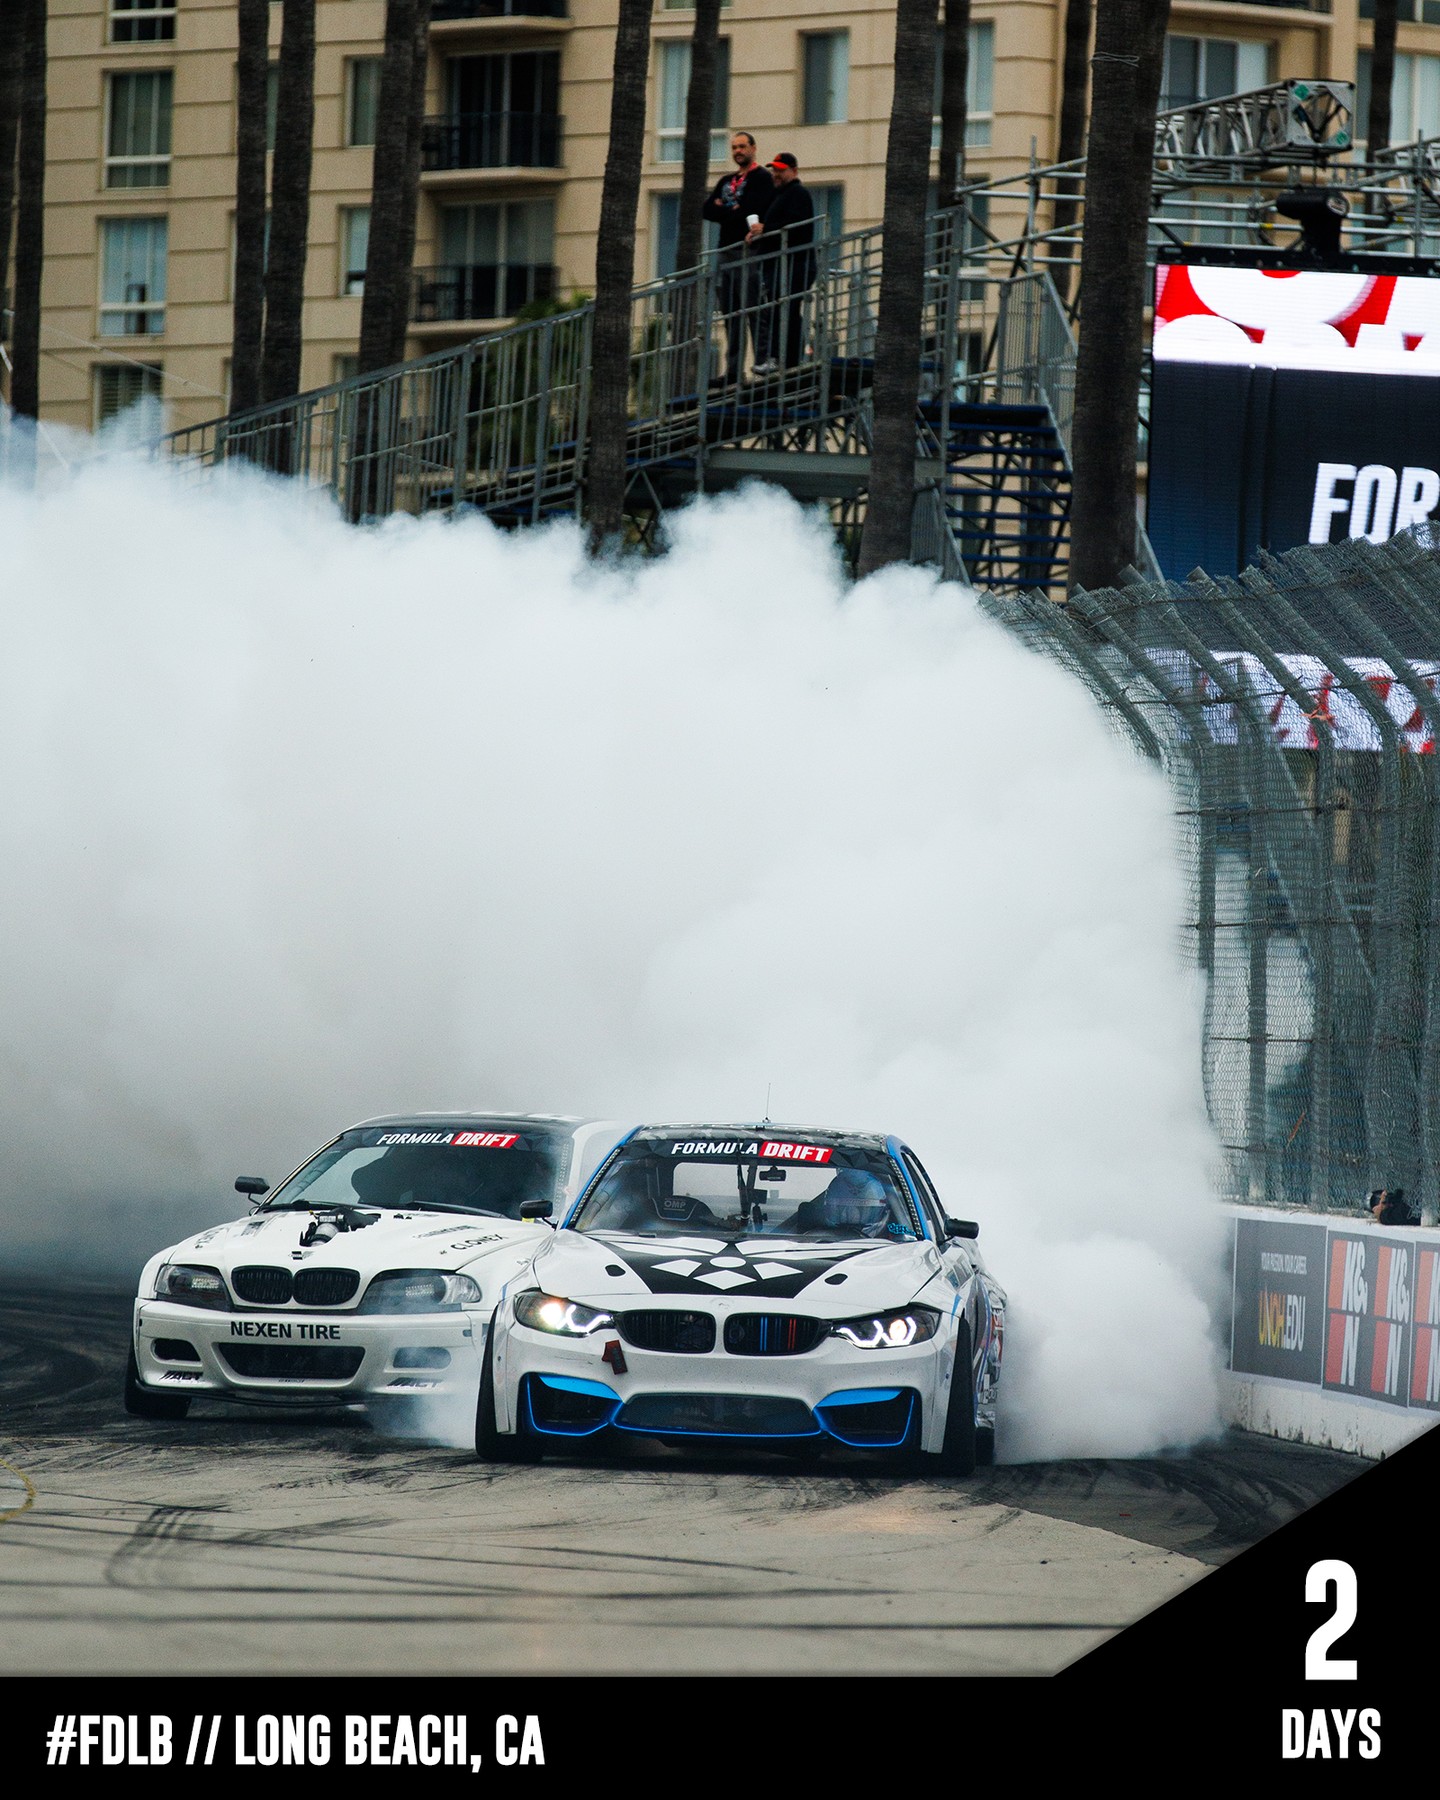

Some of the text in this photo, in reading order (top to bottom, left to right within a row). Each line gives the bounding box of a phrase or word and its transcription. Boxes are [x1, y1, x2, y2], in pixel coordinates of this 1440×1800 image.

[377, 1132, 517, 1148] FORMULA DRIFT
[671, 1142, 830, 1162] FORMULA DRIFT
[664, 1200, 686, 1209] OMP
[230, 1321, 341, 1340] NEXEN TIRE
[1340, 1315, 1360, 1387] N
[1384, 1323, 1402, 1396] N
